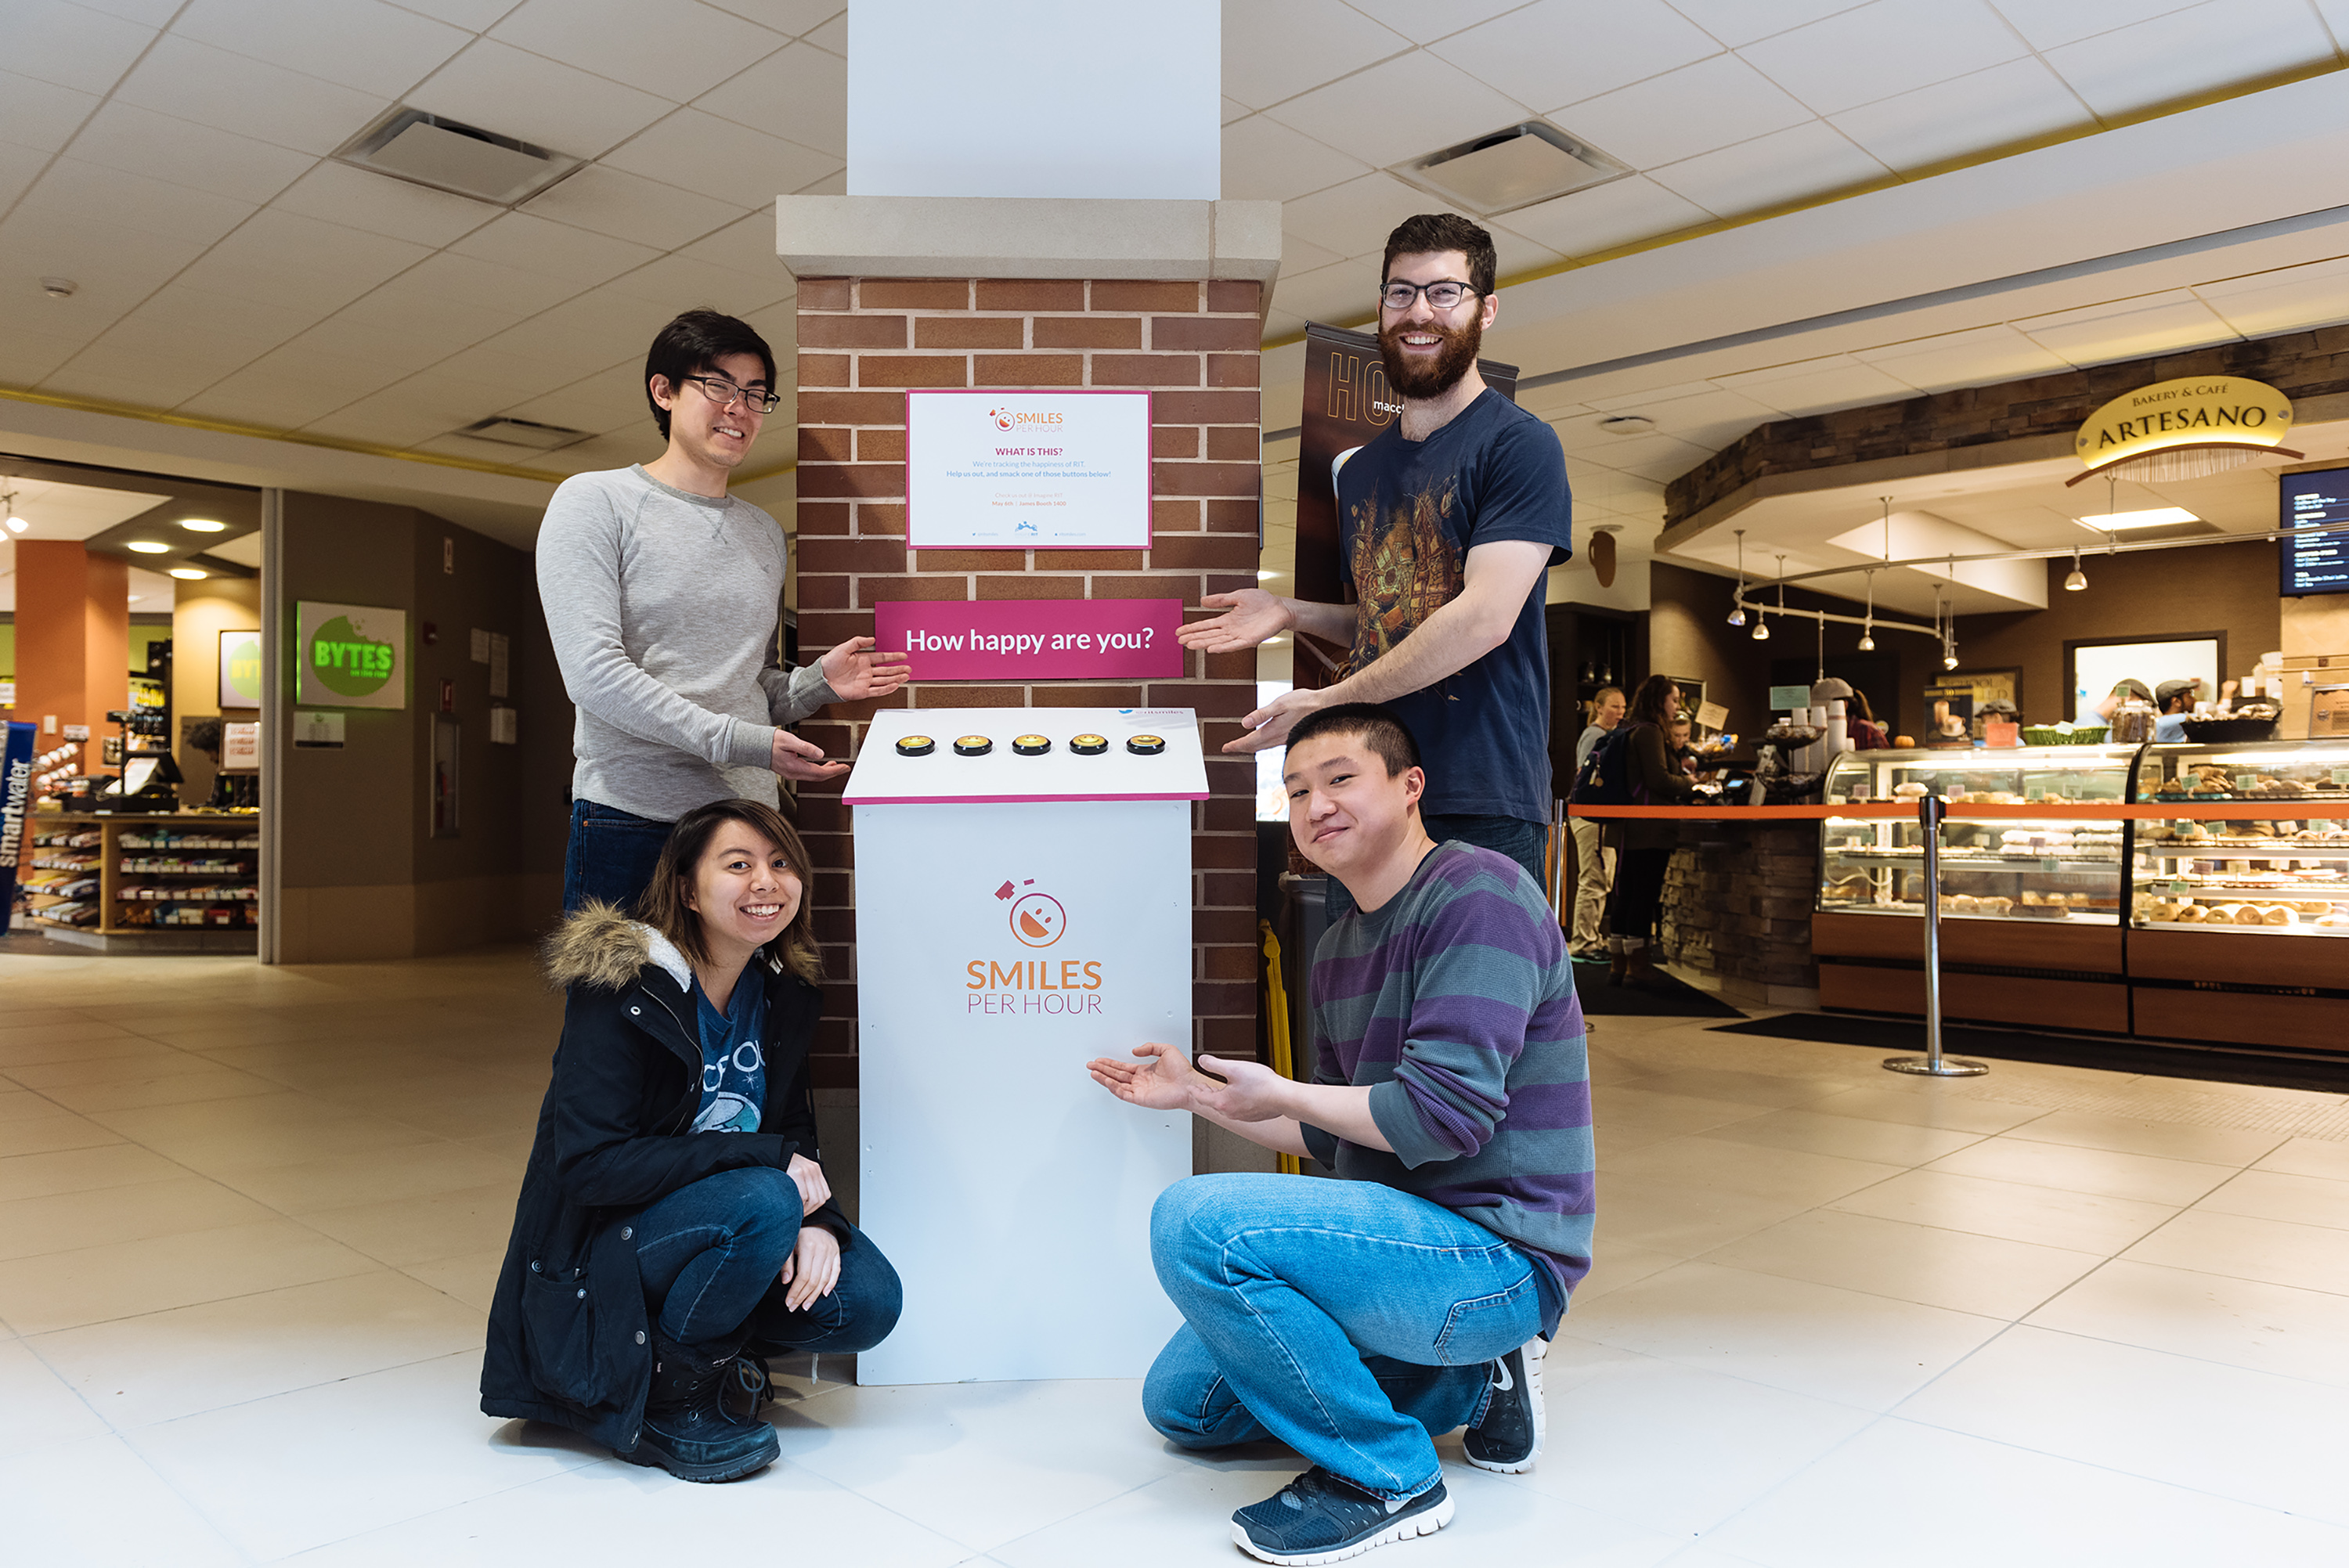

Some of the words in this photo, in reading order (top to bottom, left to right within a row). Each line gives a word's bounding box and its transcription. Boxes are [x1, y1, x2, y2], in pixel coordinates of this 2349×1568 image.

[1327, 351, 1400, 426] HO
[2132, 390, 2180, 407] BAKERY
[2181, 387, 2193, 398] &
[2196, 382, 2229, 396] CAFÉ
[1016, 413, 1063, 424] SMILES
[1373, 400, 1405, 414] macc
[1016, 424, 1034, 433] PER
[1035, 424, 1063, 433] HOUR
[2098, 405, 2267, 449] ARTESANO
[995, 447, 1026, 456] WHAT
[1027, 447, 1035, 456] IS
[1037, 447, 1063, 456] THIS?
[993, 460, 1019, 470] tracking
[1032, 460, 1064, 469] happiness
[905, 629, 965, 652] How
[969, 628, 1046, 655] happy
[1051, 633, 1092, 650] are
[1095, 626, 1155, 654] you?
[315, 639, 392, 671] BYTES
[0, 757, 32, 868] smartwater
[965, 959, 1102, 990] SMILES
[968, 993, 1016, 1015] PER
[1023, 993, 1102, 1015] HOUR
